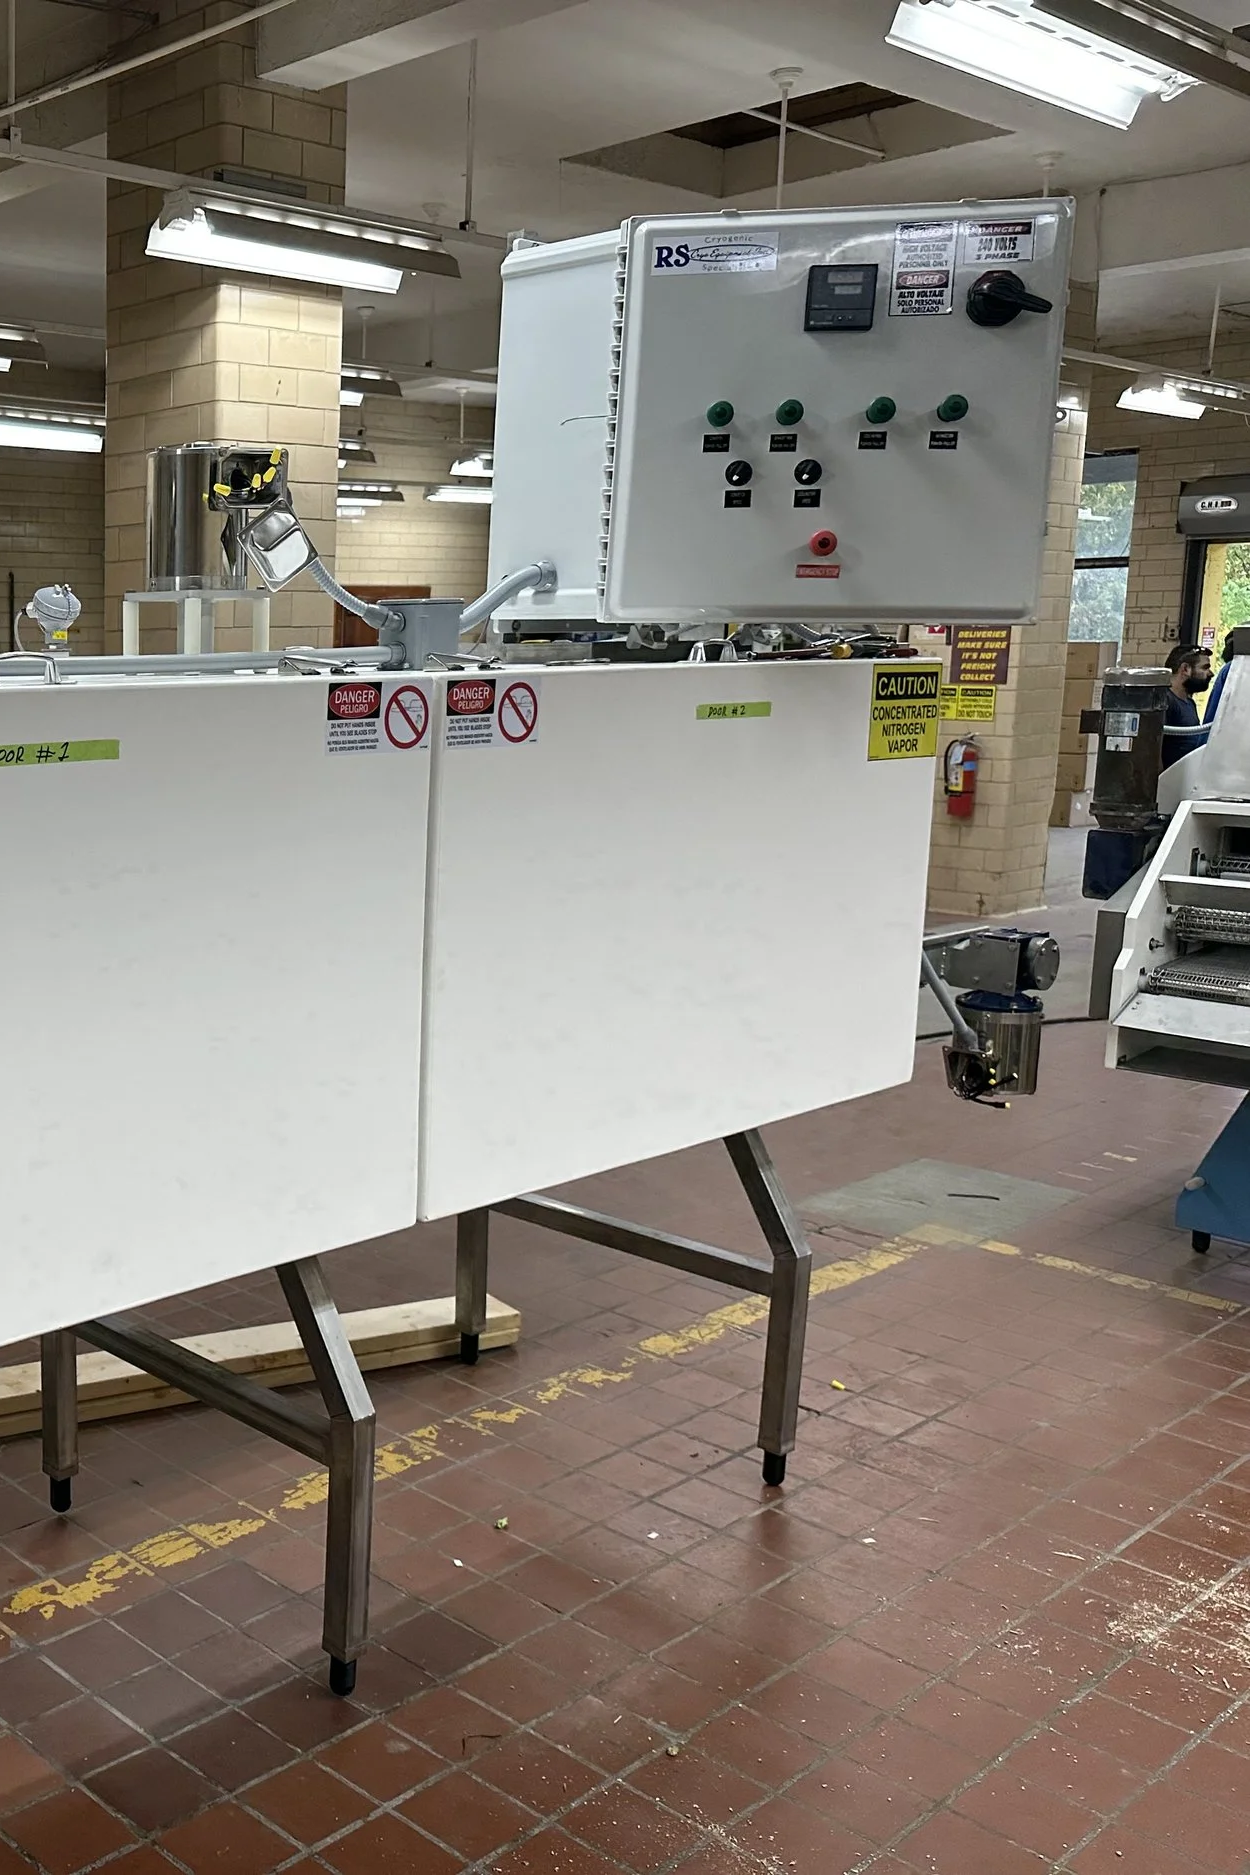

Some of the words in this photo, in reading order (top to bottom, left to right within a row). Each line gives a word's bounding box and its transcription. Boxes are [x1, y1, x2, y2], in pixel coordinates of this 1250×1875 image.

[704, 235, 753, 244] Cryogenic
[994, 237, 1018, 250] VOLTS
[654, 244, 690, 268] RS
[984, 252, 1020, 260] PHASE
[906, 275, 939, 285] DANGER
[958, 630, 1006, 638] DELIVERIES
[984, 641, 1007, 649] SURE
[878, 676, 936, 696] CAUTION
[335, 690, 375, 704] DANGER
[453, 687, 490, 700] DANGER
[340, 704, 369, 714] PELIGRO
[458, 700, 484, 709] PELIGRO
[872, 705, 938, 720] CONCENTRATED
[882, 722, 926, 736] NITROGEN
[888, 739, 918, 753] VAPOR
